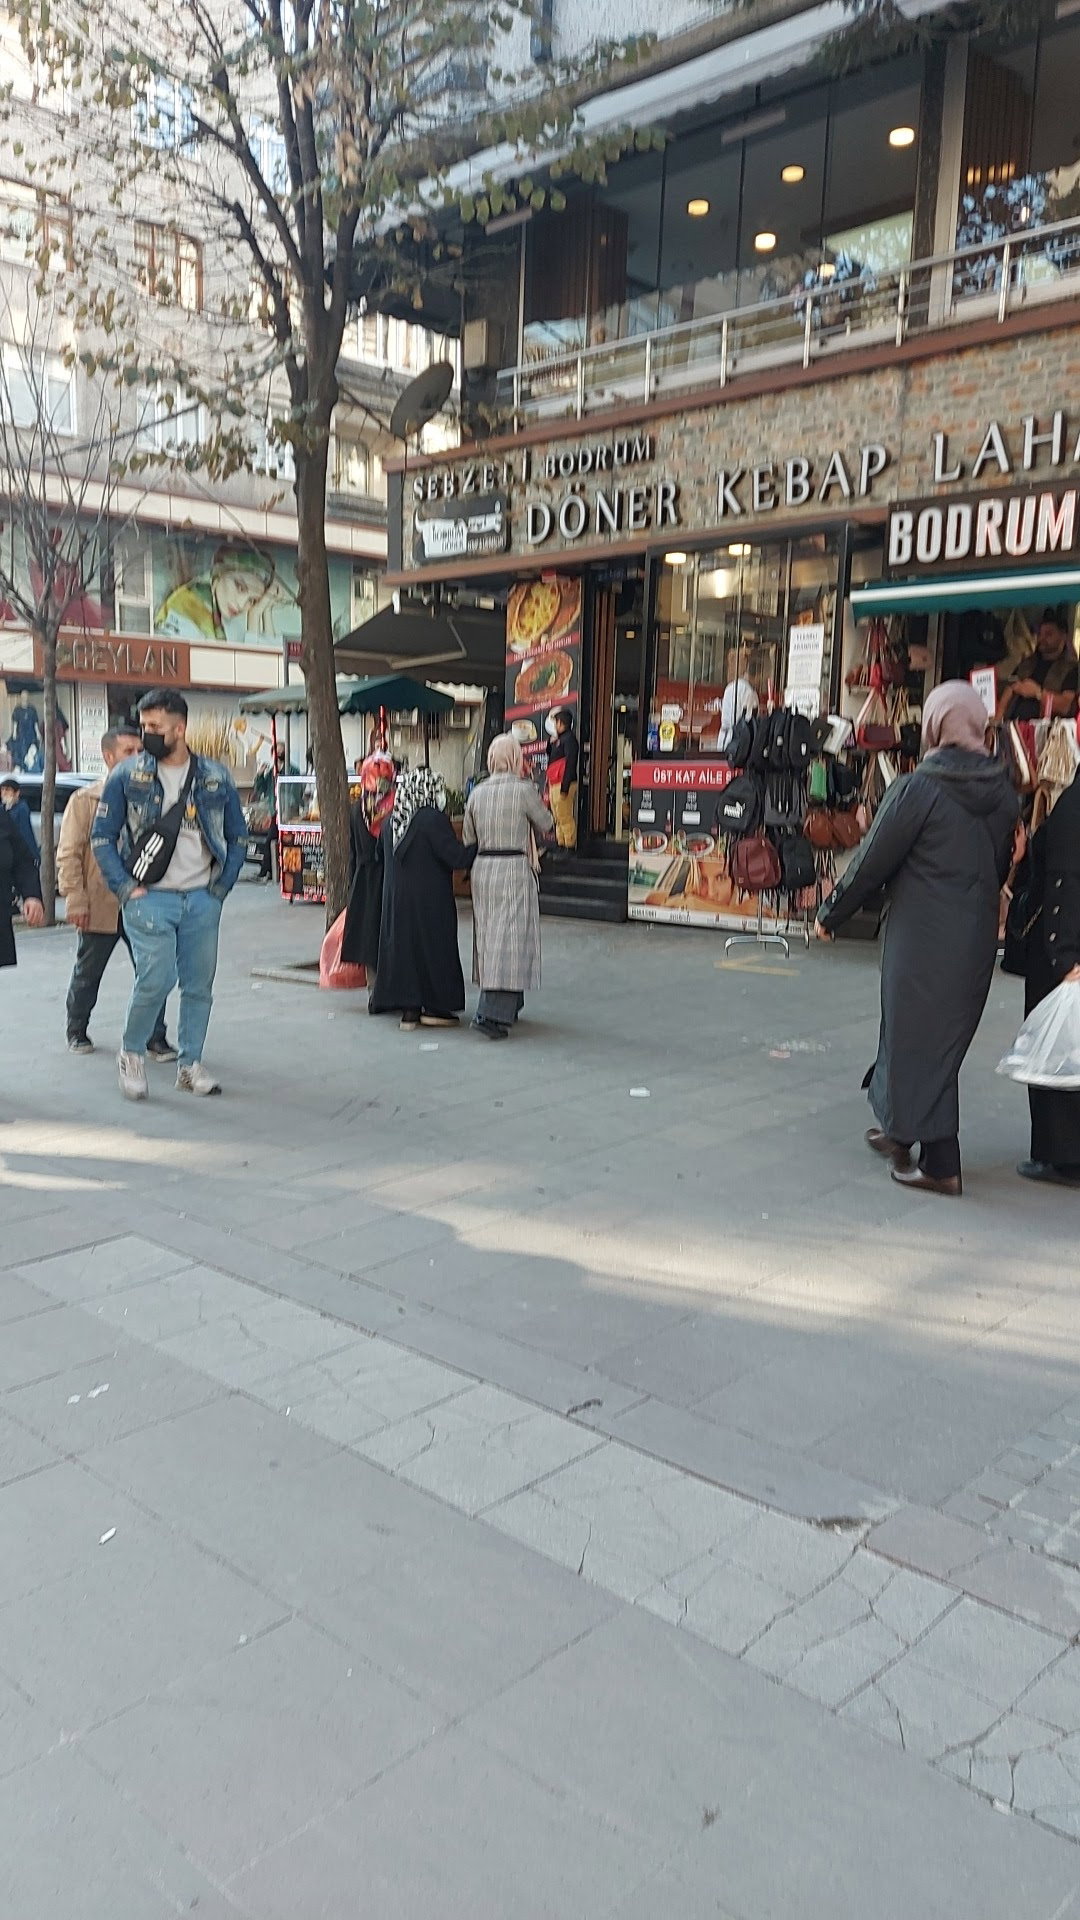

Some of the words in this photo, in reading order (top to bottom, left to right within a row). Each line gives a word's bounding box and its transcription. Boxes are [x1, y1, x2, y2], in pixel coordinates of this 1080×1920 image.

[526, 480, 679, 545] DÖNER
[716, 443, 888, 517] KEBAP
[933, 410, 1080, 483] LAH
[545, 434, 650, 479] BODRUM
[888, 490, 1076, 565] BODRUM
[675, 769, 696, 785] KAT
[698, 767, 722, 785] AİLE
